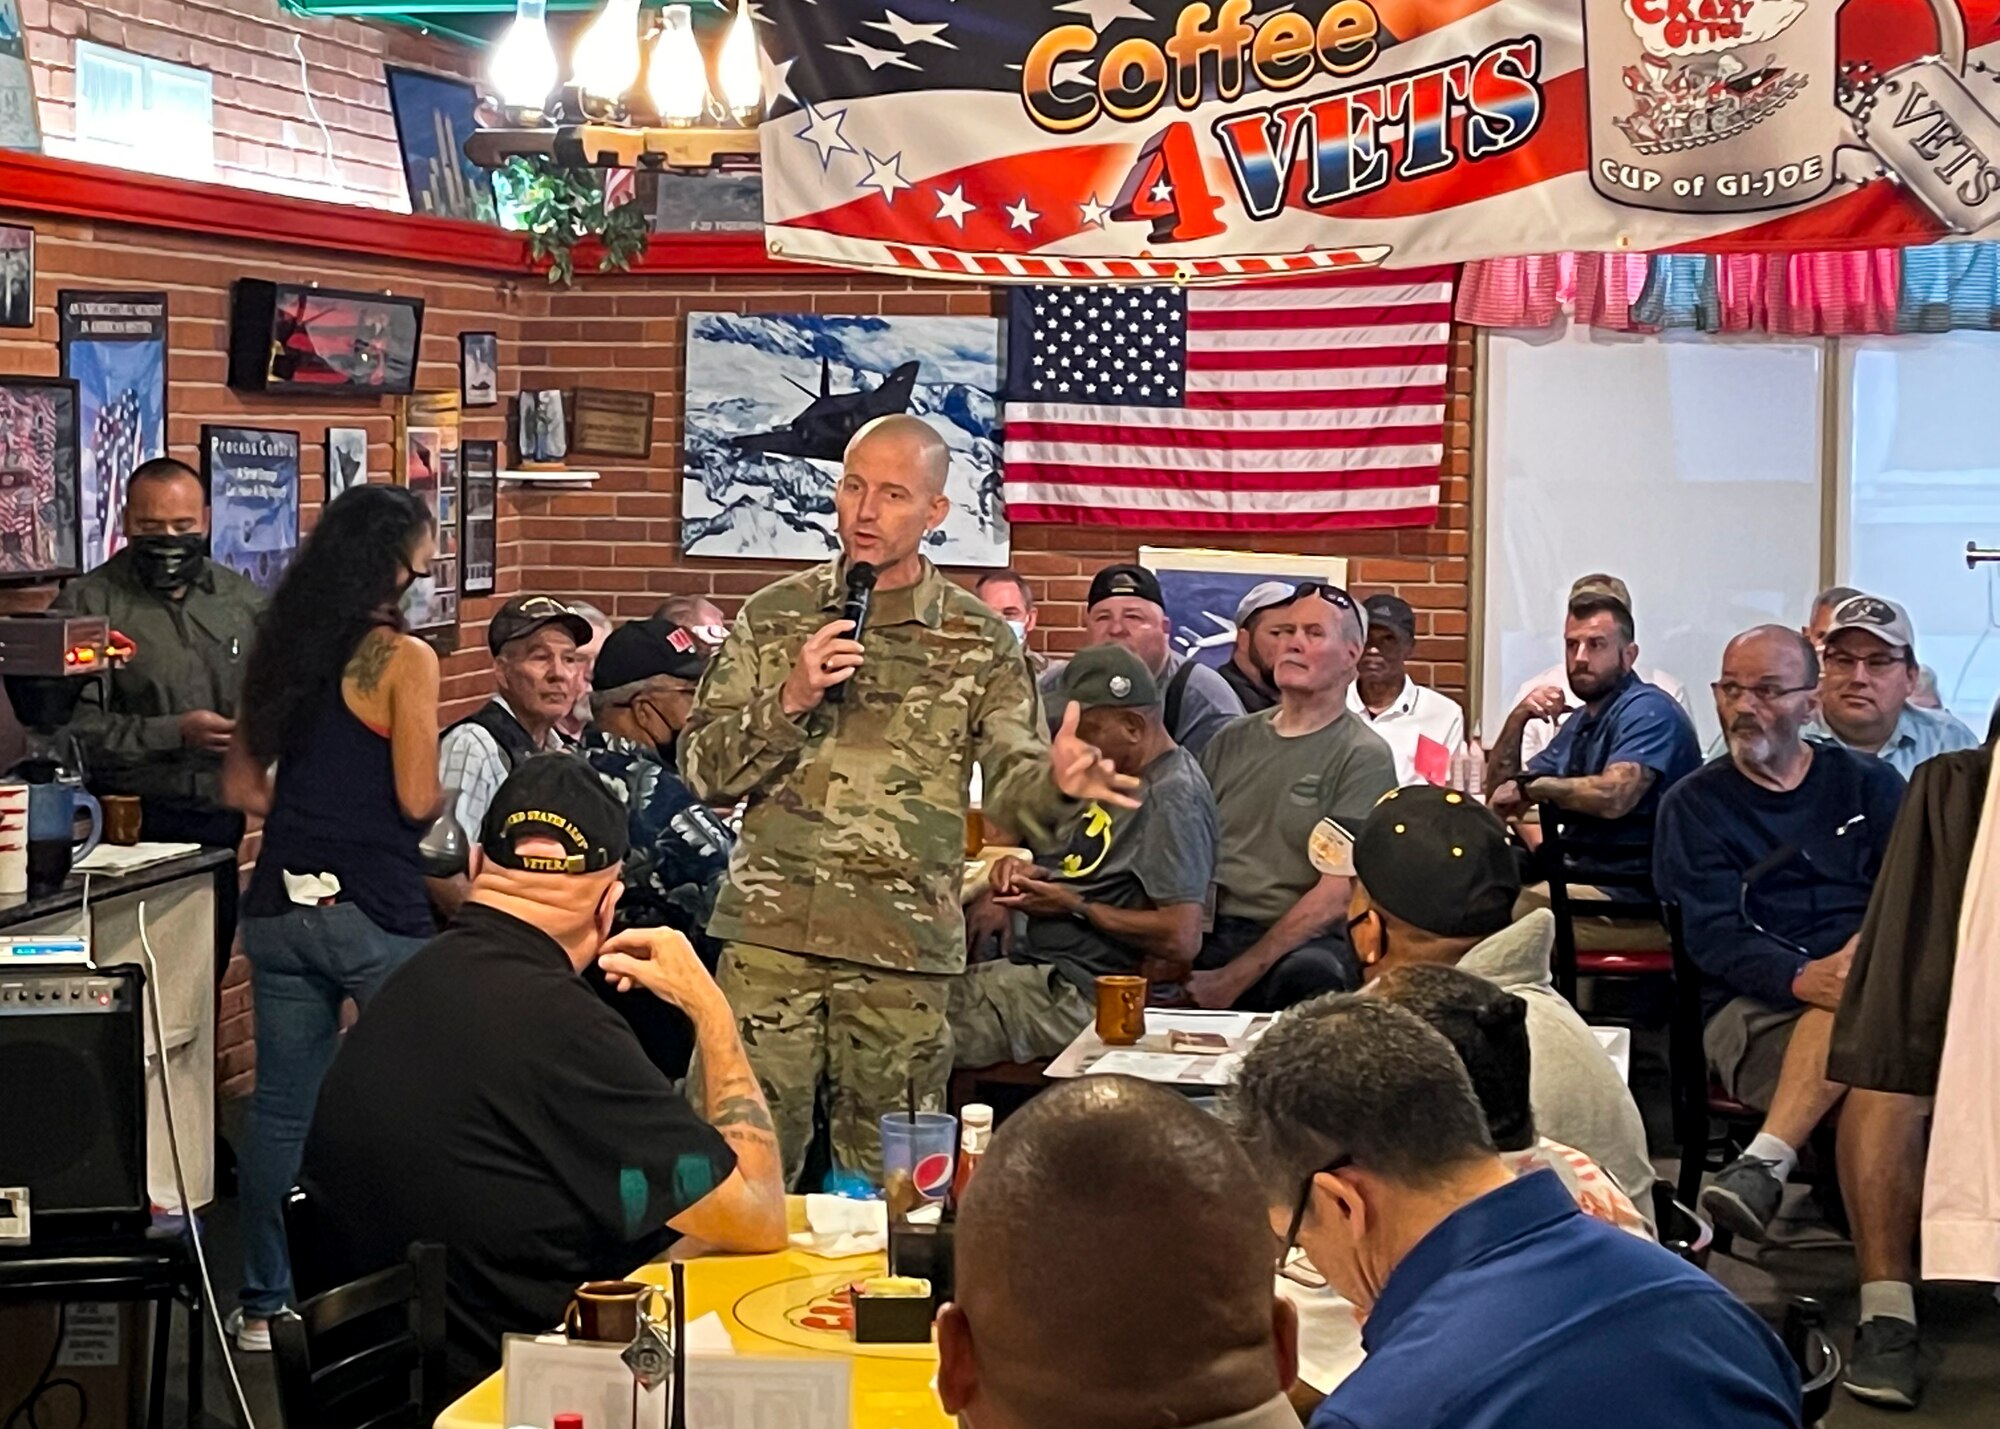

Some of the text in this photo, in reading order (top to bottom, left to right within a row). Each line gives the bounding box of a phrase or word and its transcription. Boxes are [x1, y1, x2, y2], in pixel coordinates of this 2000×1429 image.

[1630, 0, 1754, 24] CRAZY
[1022, 0, 1381, 132] Coffee
[1112, 37, 1541, 243] 4 VETS
[1599, 154, 1823, 197] CUP of GI-JOE
[1893, 81, 2000, 206] VETS
[523, 856, 569, 871] VETERA
